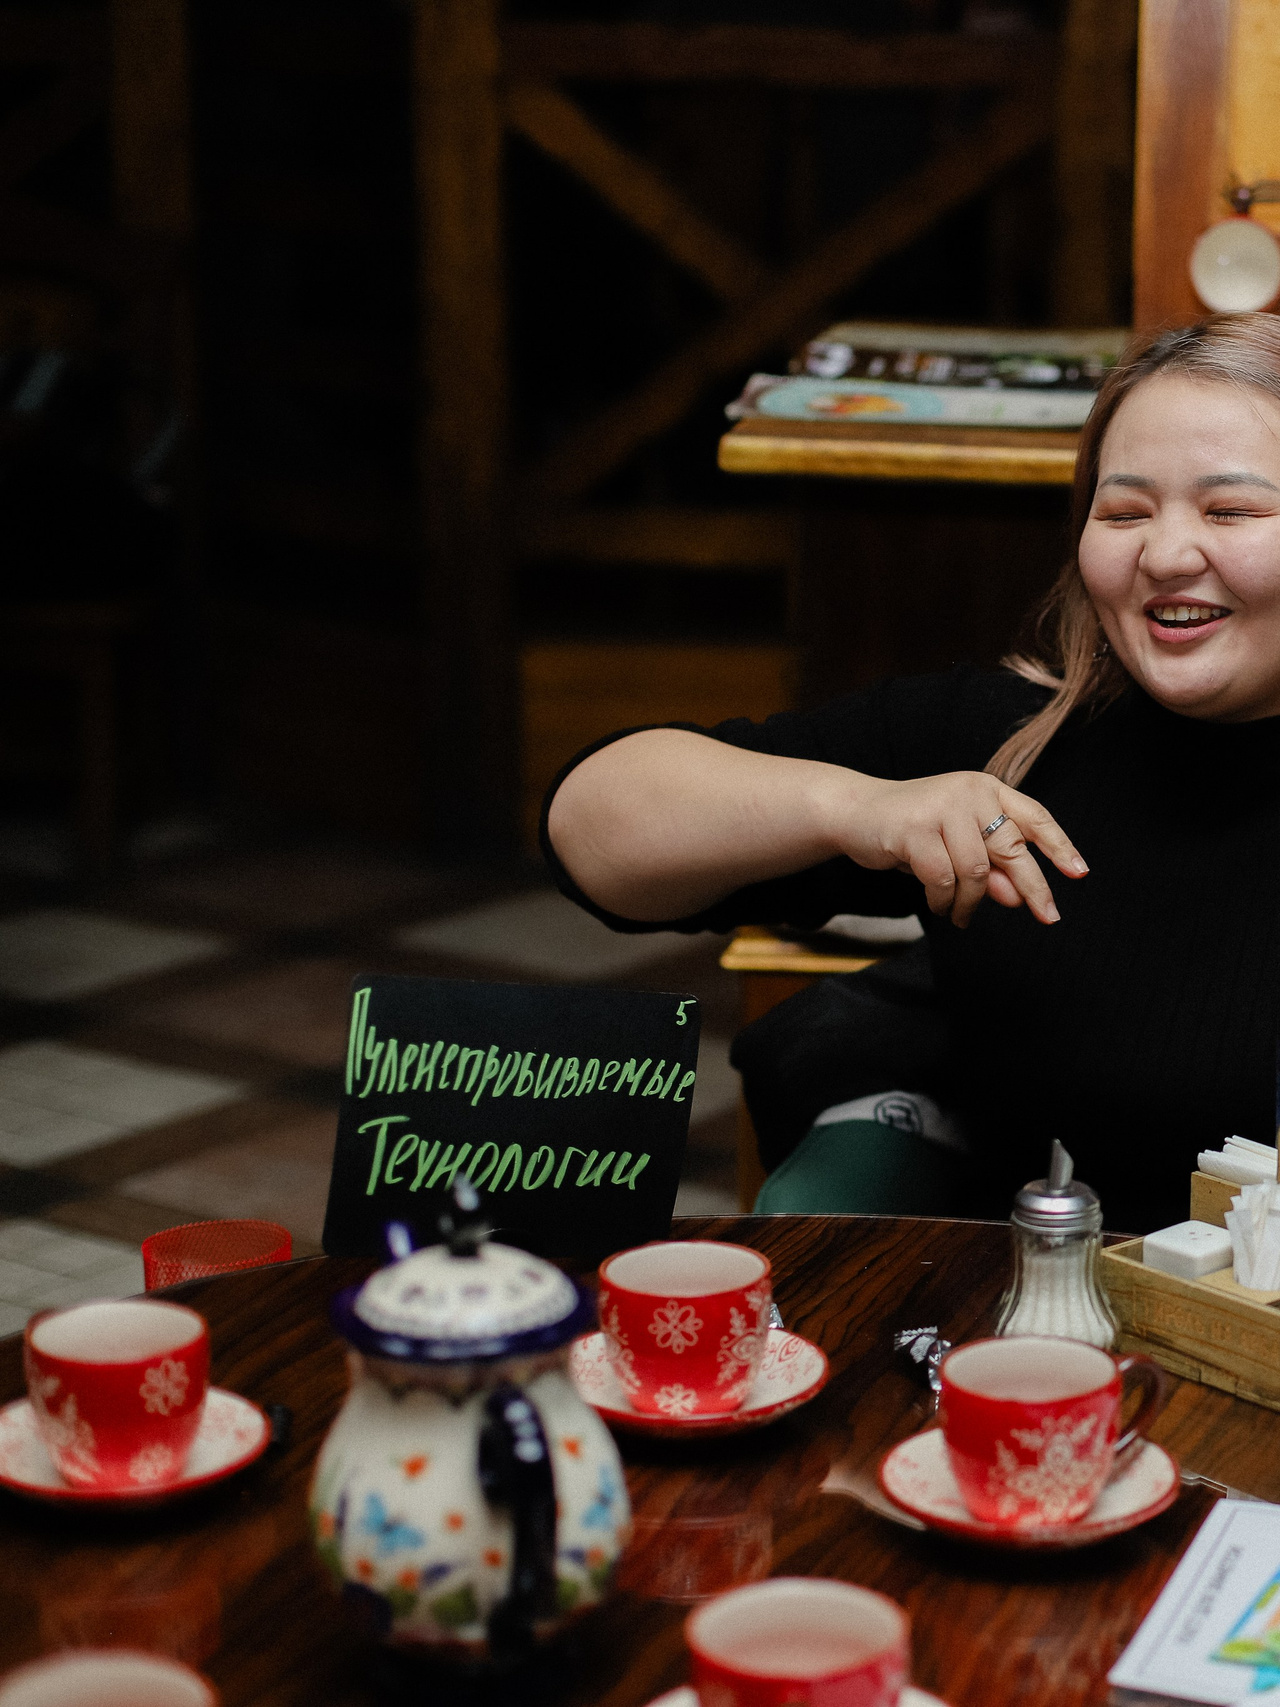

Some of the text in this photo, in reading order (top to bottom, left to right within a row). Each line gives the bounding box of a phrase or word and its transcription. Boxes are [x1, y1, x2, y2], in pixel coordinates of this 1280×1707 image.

[345, 987, 696, 1106] Пуленепробиваемые
[676, 1000, 697, 1026] 5
[357, 1115, 651, 1196] Технологии
